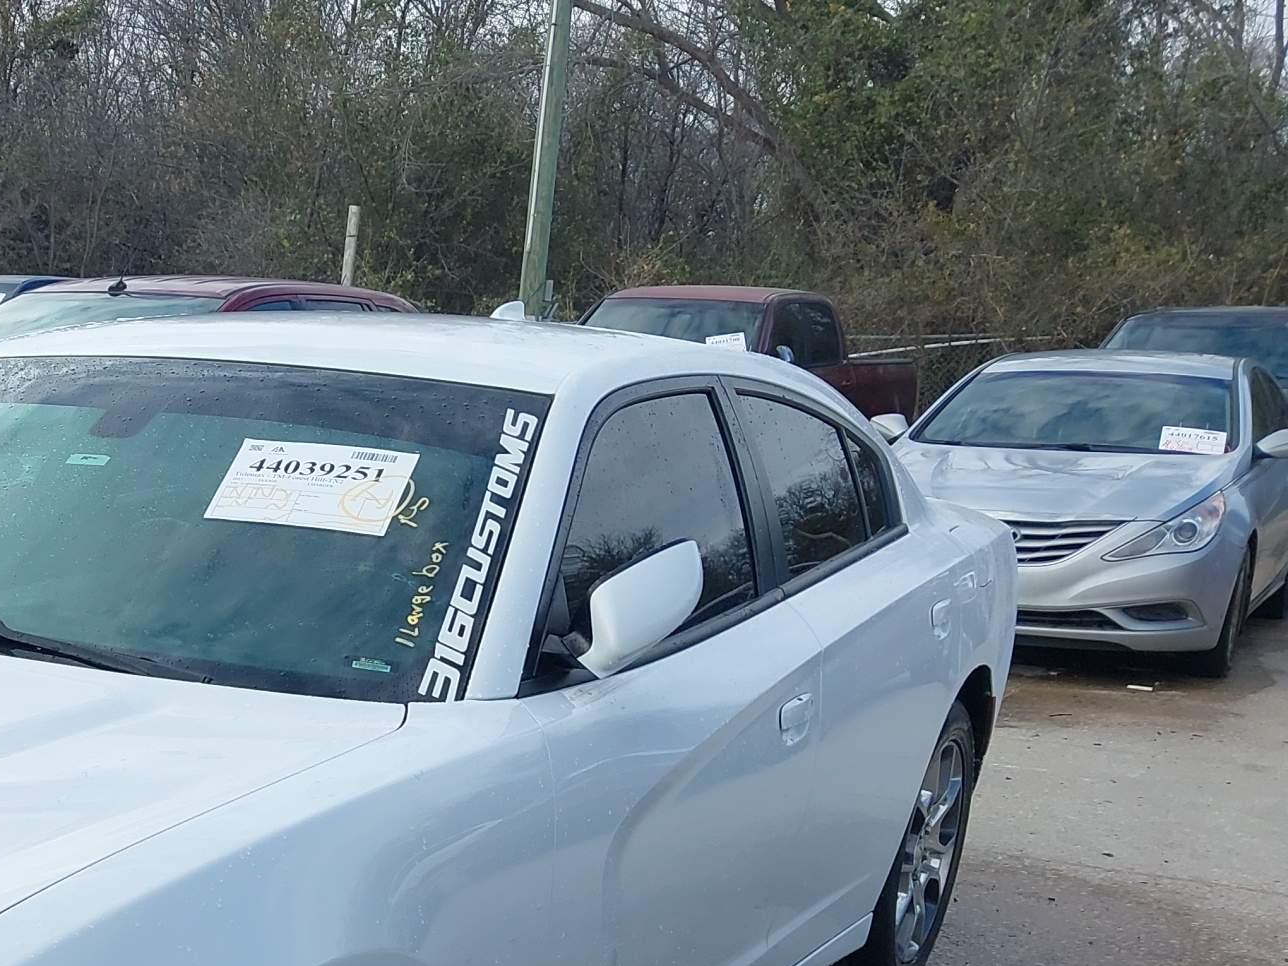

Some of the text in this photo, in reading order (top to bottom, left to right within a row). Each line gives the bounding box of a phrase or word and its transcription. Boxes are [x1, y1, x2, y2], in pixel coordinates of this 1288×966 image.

[249, 458, 385, 482] 44039251
[412, 541, 449, 577] box
[418, 408, 539, 704] 316CUSTOMS
